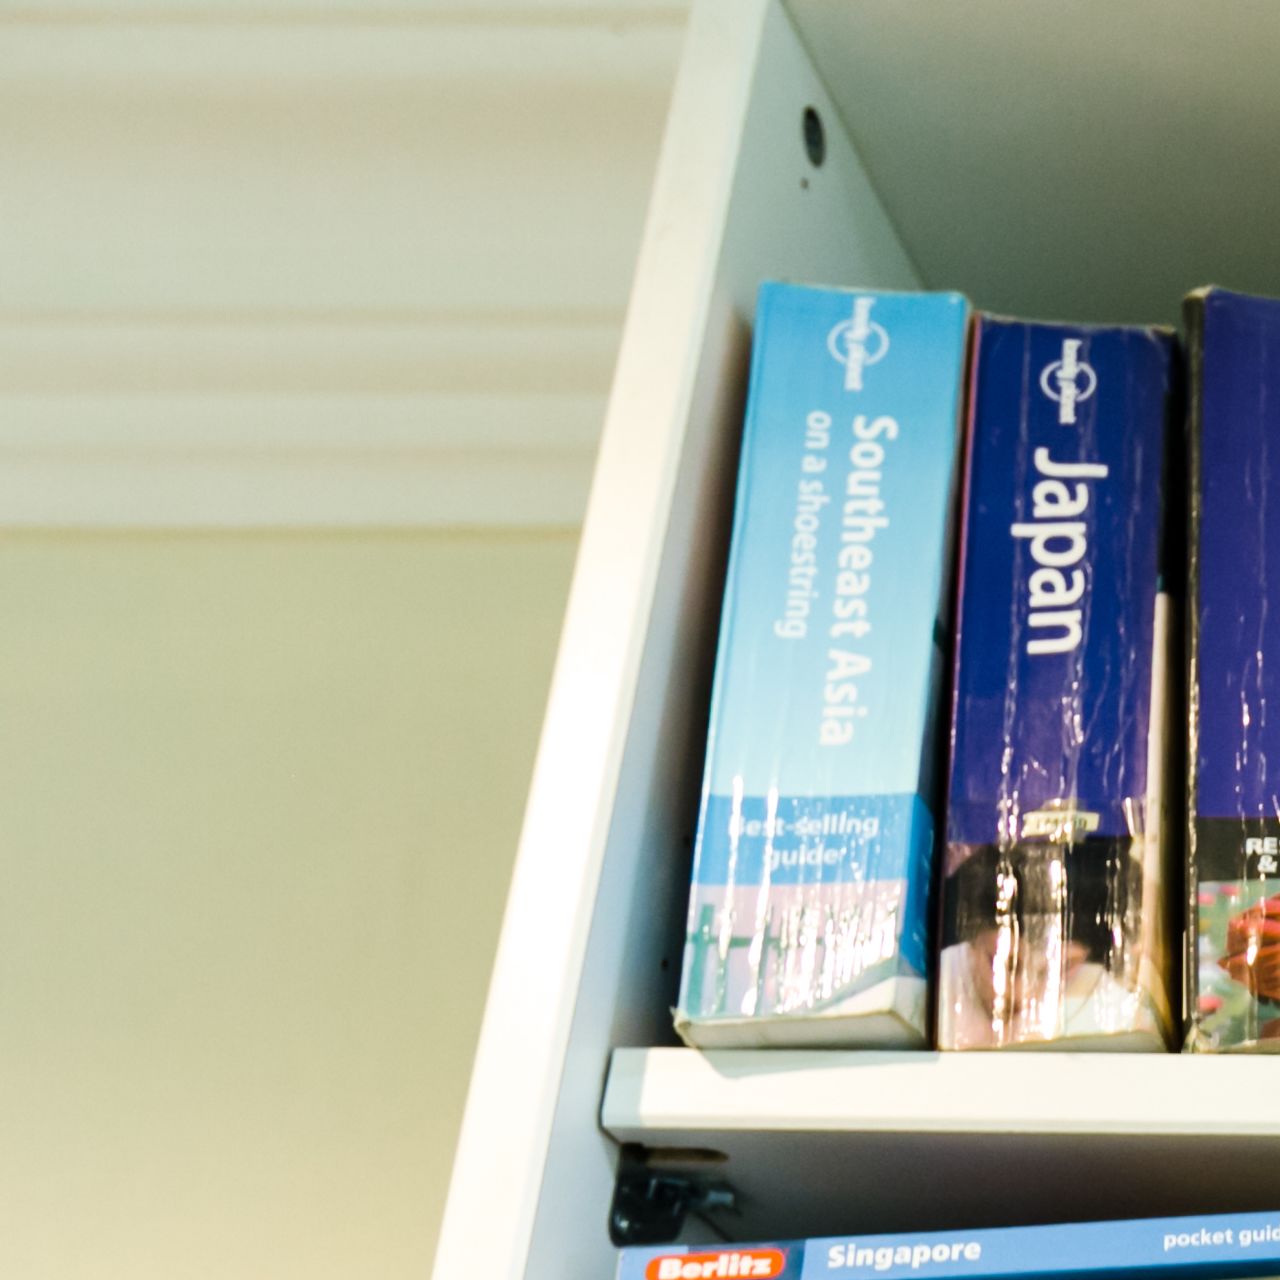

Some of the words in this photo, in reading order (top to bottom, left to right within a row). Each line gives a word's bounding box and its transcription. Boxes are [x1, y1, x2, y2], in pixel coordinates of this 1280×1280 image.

[1011, 448, 1108, 654] Japan
[1163, 1228, 1234, 1252] pocket
[657, 1252, 773, 1280] Berlitz
[827, 1240, 982, 1270] Singapore
